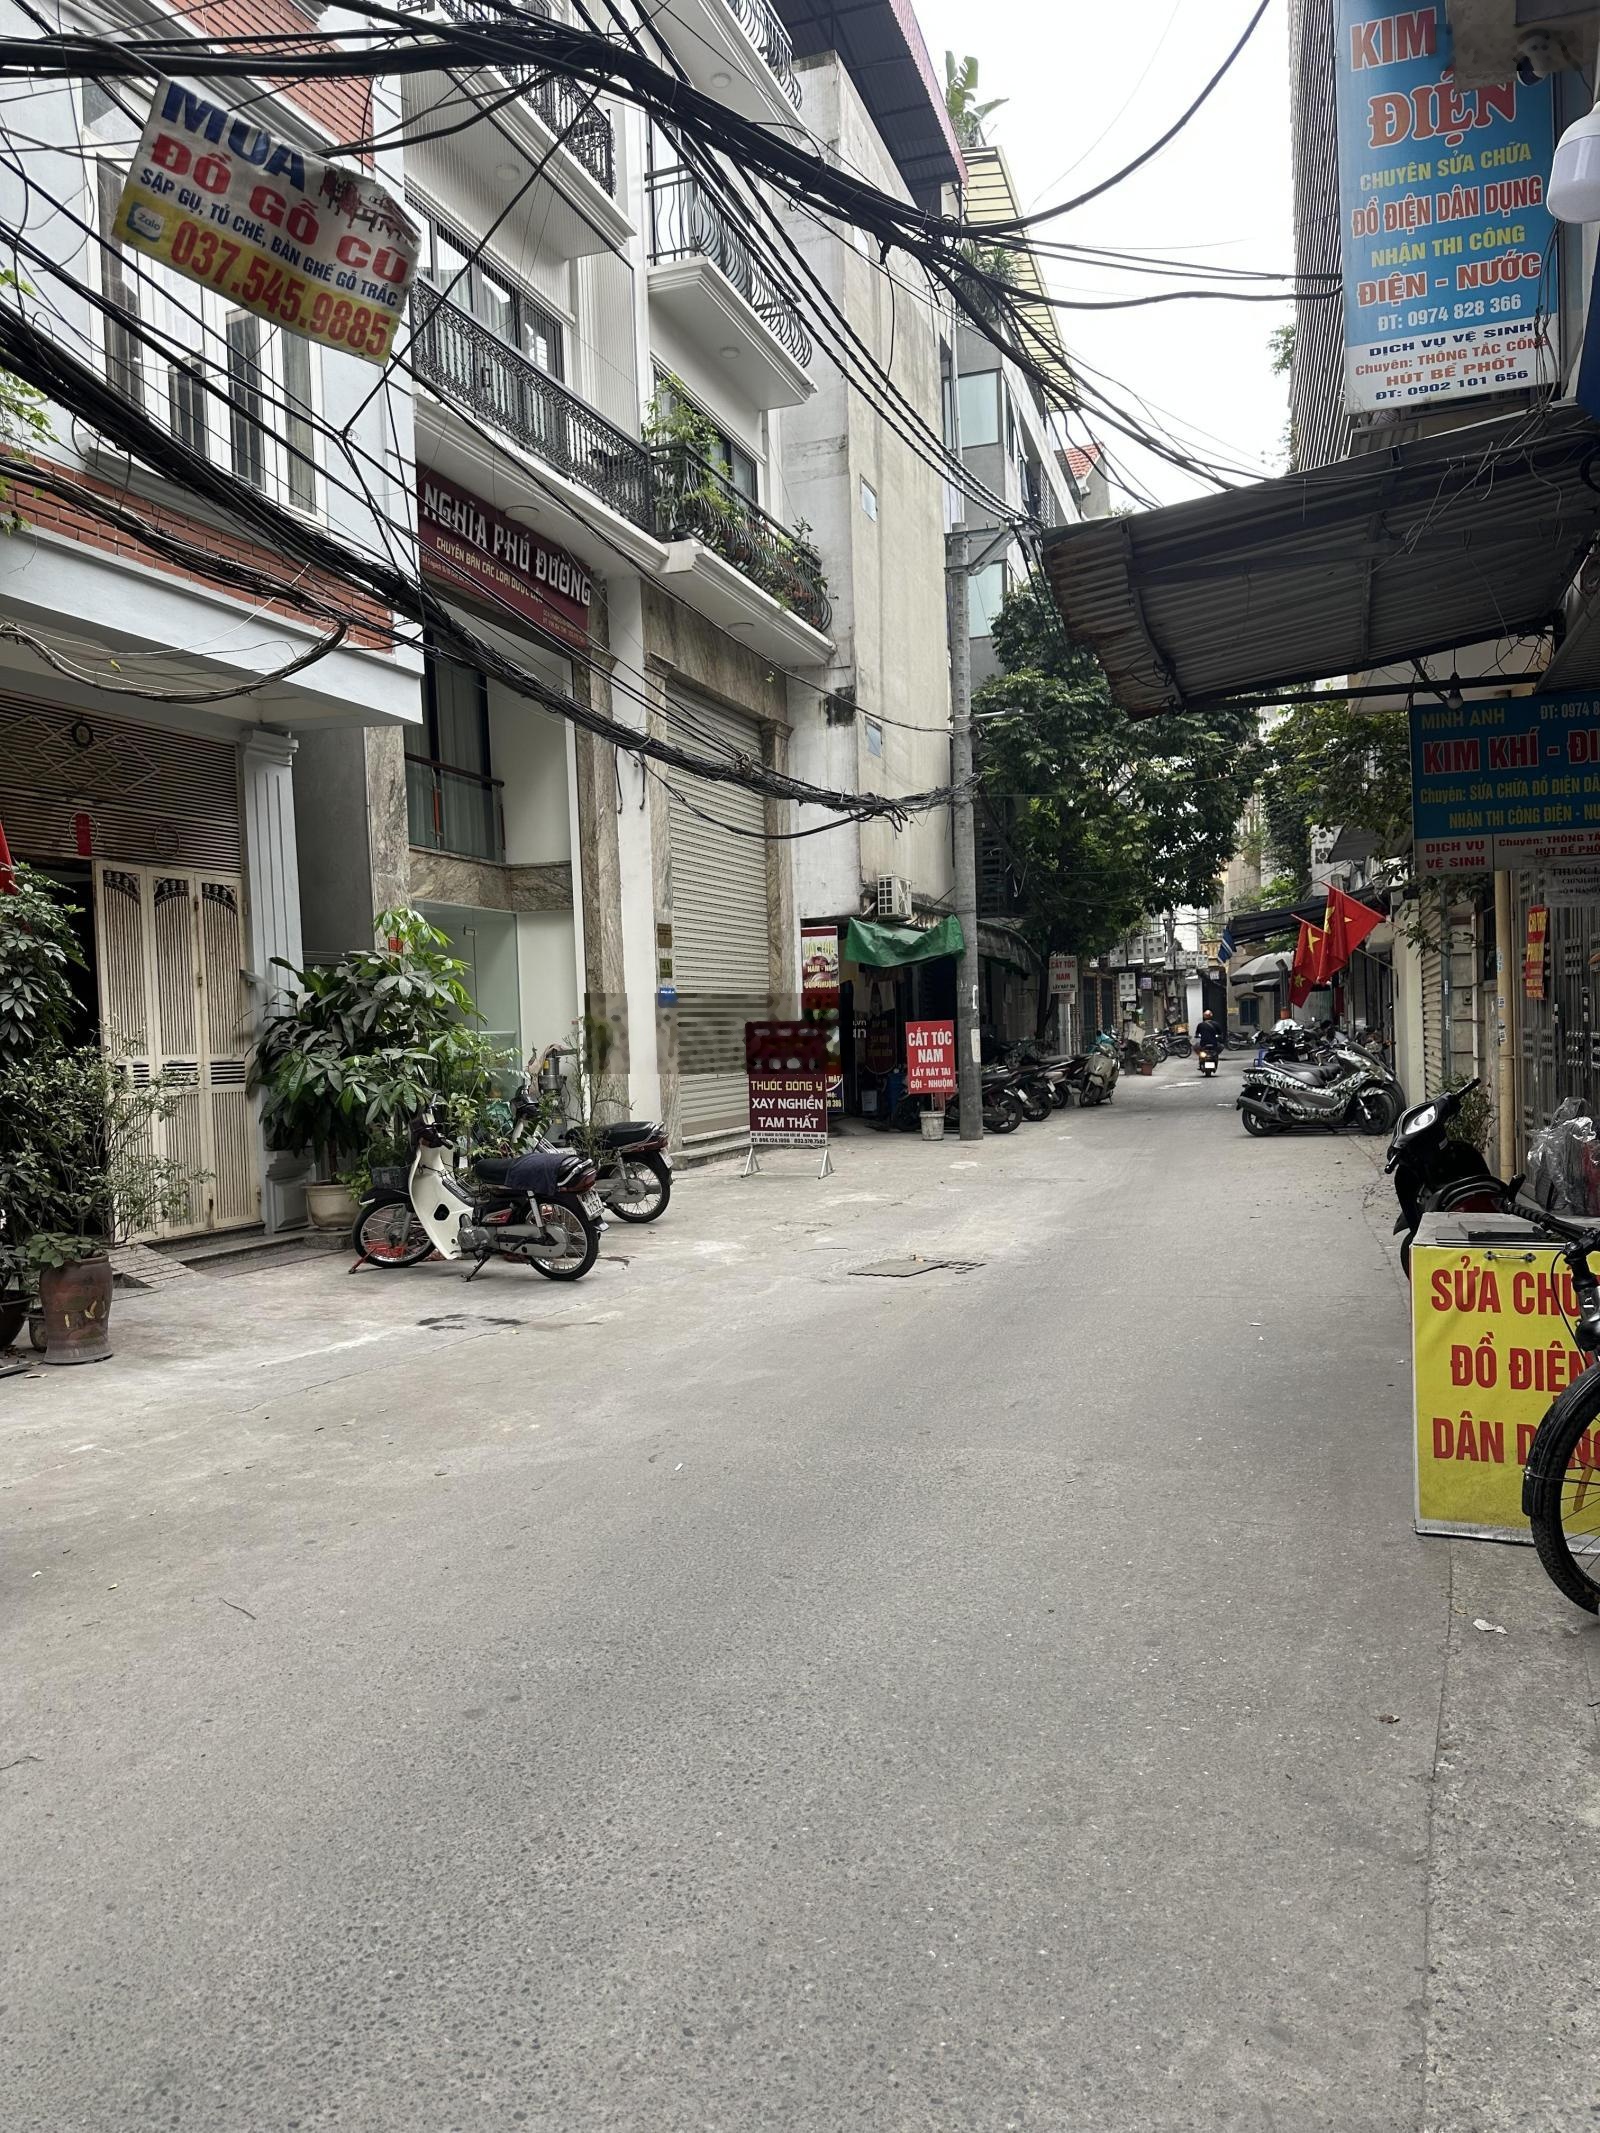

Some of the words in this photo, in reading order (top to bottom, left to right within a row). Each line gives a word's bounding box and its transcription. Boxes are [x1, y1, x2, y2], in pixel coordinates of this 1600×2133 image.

[1350, 7, 1437, 73] KIM
[1367, 66, 1516, 149] ĐIỆN
[161, 81, 306, 193] MUA
[1359, 160, 1432, 192] CHUYÊN
[1438, 149, 1475, 177] SỬA
[1481, 141, 1531, 169] CHỮA
[137, 212, 161, 231] Zalo
[151, 133, 232, 195] ĐỒ
[249, 185, 320, 246] GỖ
[335, 235, 409, 283] CŨ
[1352, 197, 1379, 238] ĐỒ
[1384, 192, 1432, 235] ĐIỆN
[1436, 183, 1481, 222] DÂN
[1485, 175, 1543, 218] DỤNG
[140, 167, 176, 195] SẬP
[180, 187, 203, 216] GỤ,
[210, 201, 231, 225] TỦ
[272, 234, 300, 268] BÀN
[303, 257, 336, 283] GHẾ
[336, 269, 357, 291] GỖ
[360, 279, 398, 308] TRẮC
[1372, 240, 1426, 269] NHẬN
[1432, 235, 1463, 257] THI
[1469, 225, 1526, 251] CÔNG
[170, 219, 391, 356] 037.545.9885
[1357, 271, 1428, 308] ĐIỆN
[1456, 248, 1542, 291] NƯỚC
[1378, 313, 1403, 332] ĐT:
[1407, 306, 1449, 327] 0974
[1453, 300, 1485, 320] 828
[1490, 293, 1522, 314] 366
[1369, 341, 1415, 357] DỊCH
[1421, 336, 1447, 350] VỤ
[1453, 331, 1477, 344] VỆ
[1484, 322, 1533, 338] SINH
[1355, 358, 1413, 377] Chuyên:
[1417, 349, 1468, 366] THÔNG
[1386, 369, 1424, 387] HÚT
[1464, 354, 1517, 375] PHỐT
[1375, 389, 1402, 400] ĐT:
[1407, 381, 1451, 396] 0902
[1457, 376, 1487, 388] 101
[1495, 369, 1529, 383] 656
[423, 483, 488, 549] NGHĨA
[493, 522, 530, 573] PHÚ
[535, 547, 592, 607] ĐƯỜNG
[436, 536, 465, 562] CHUYÊN
[466, 551, 481, 570] BÁN
[481, 559, 495, 578] CÁC
[1421, 712, 1464, 730] MINH
[1469, 707, 1505, 726] ANH
[1540, 705, 1558, 721] ĐT:
[1561, 702, 1589, 718] 0974
[1423, 738, 1480, 776] KIM
[1488, 726, 1541, 771] KHÍ
[1420, 788, 1466, 804] Chuyên:
[1470, 778, 1493, 801] SỬA
[1497, 777, 1529, 799] CHỮA
[1532, 774, 1548, 796] ĐỒ
[1551, 774, 1580, 798] ĐIỆN
[1450, 807, 1483, 831] NHẬN
[1486, 810, 1504, 826] THI
[1508, 804, 1540, 825] CÔNG
[1544, 802, 1572, 826] ĐIỆN
[1425, 841, 1460, 856] DỊCH
[1466, 839, 1486, 854] VỤ
[1498, 837, 1544, 848] Chuyên:
[1546, 832, 1584, 845] THÔNG
[1425, 857, 1444, 871] VỆ
[1449, 856, 1486, 868] SINH
[1056, 972, 1071, 981] NAM
[908, 1027, 928, 1047] CẮT
[931, 1028, 952, 1046] TÓC
[912, 1066, 924, 1077] LẤY
[941, 1067, 951, 1076] TAI
[918, 1048, 944, 1063] NAM
[751, 1077, 782, 1091] THUỐC
[910, 1079, 923, 1090] GỘI
[928, 1078, 954, 1089] NHUỘM
[752, 1098, 776, 1109] XAY
[778, 1094, 824, 1110] NGHIỀN
[758, 1117, 784, 1128] TAM
[787, 1113, 818, 1129] THẤT
[1431, 1255, 1502, 1315] SỬA
[1450, 1331, 1497, 1389] ĐỒ
[1432, 1410, 1504, 1464] DÂN
